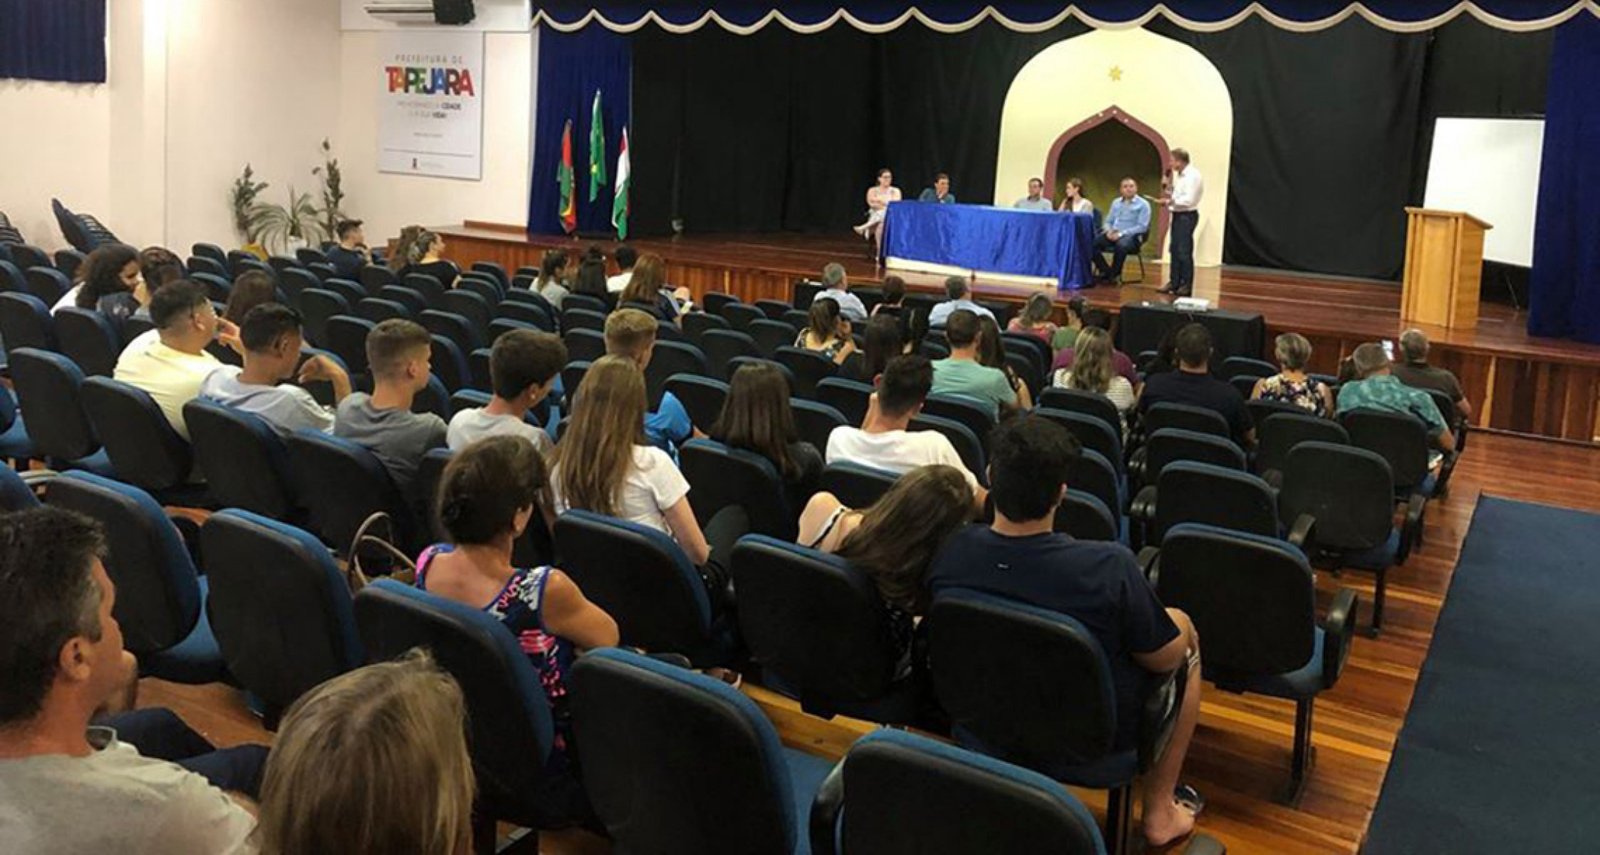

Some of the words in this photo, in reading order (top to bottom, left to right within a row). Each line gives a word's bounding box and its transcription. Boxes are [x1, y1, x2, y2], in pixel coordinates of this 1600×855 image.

[395, 54, 447, 63] PREFEITURA
[451, 55, 463, 64] DE
[385, 66, 475, 97] TAPEJARA
